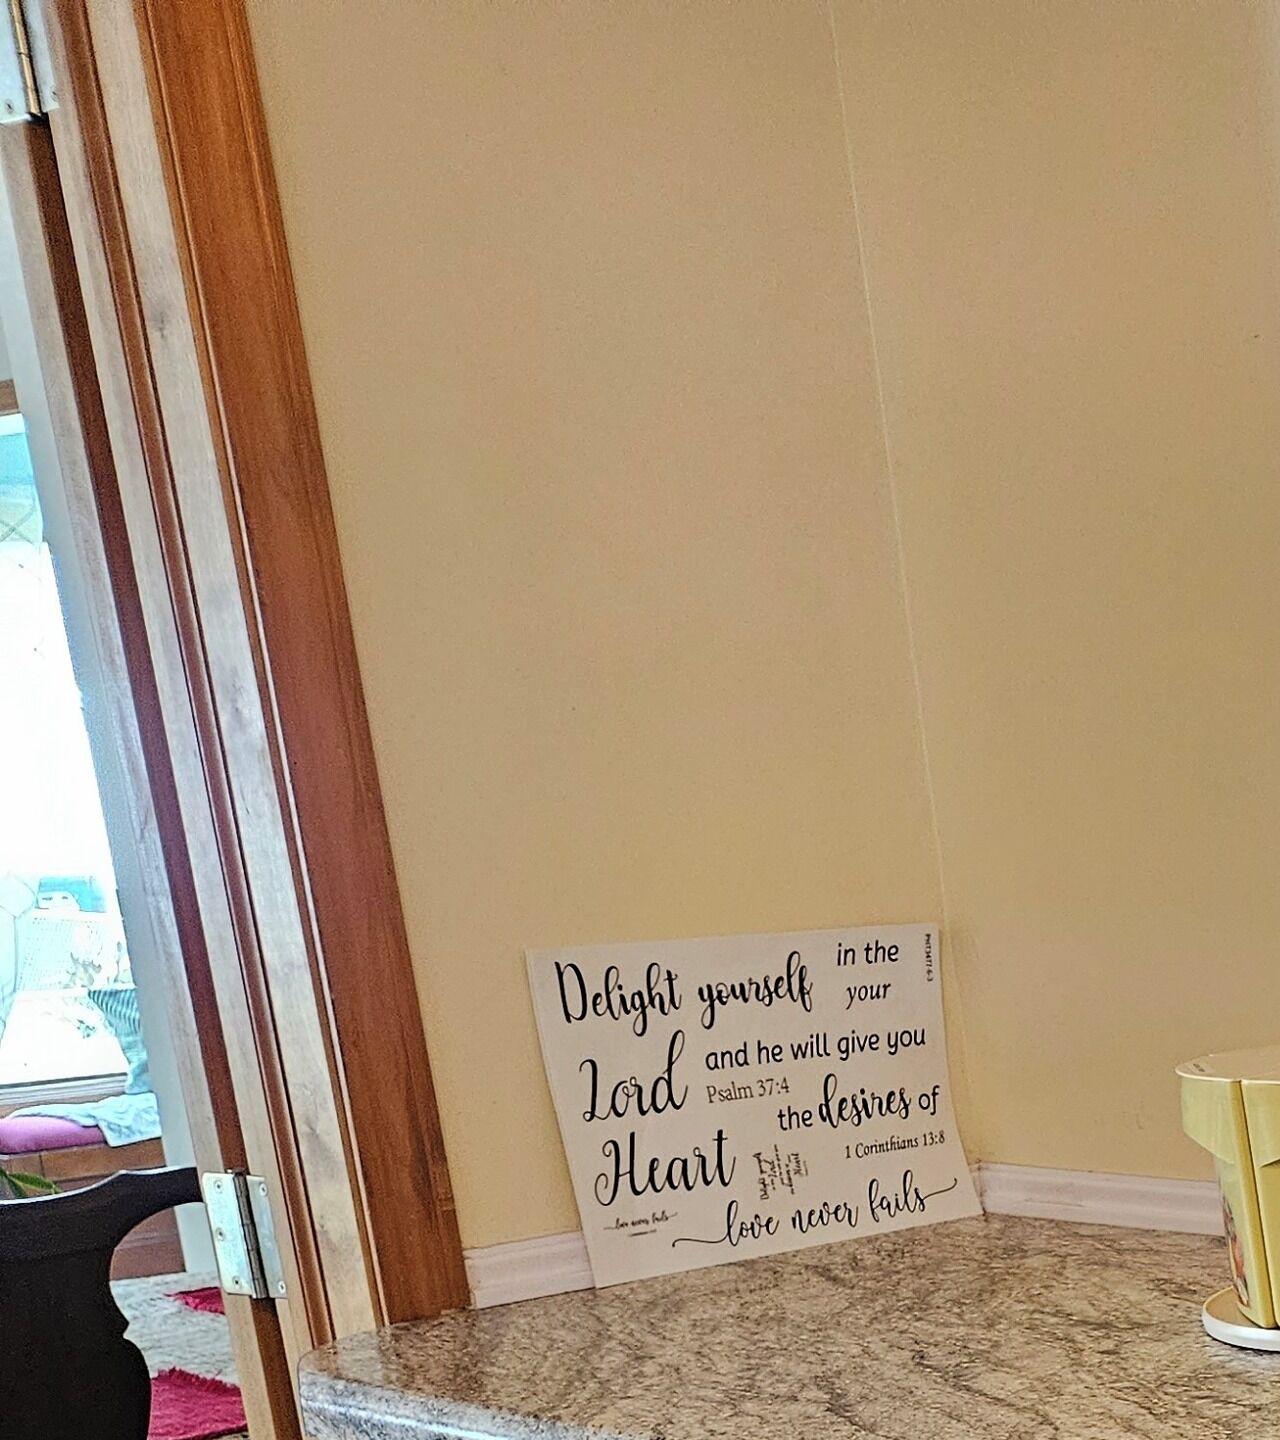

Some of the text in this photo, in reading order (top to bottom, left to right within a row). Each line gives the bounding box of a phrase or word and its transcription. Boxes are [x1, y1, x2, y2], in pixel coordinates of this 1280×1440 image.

[837, 939, 900, 967] in the
[554, 951, 814, 1037] Delight yourself
[846, 981, 892, 1011] your
[705, 1027, 926, 1072] and he will give you
[578, 1029, 689, 1123] Lord
[706, 1077, 791, 1104] Psalm 37:4
[777, 1073, 941, 1131] the desires of
[594, 1129, 737, 1207] Heart
[845, 1130, 946, 1160] 1 Corinthians 13:8
[672, 1169, 957, 1247] love never fails
